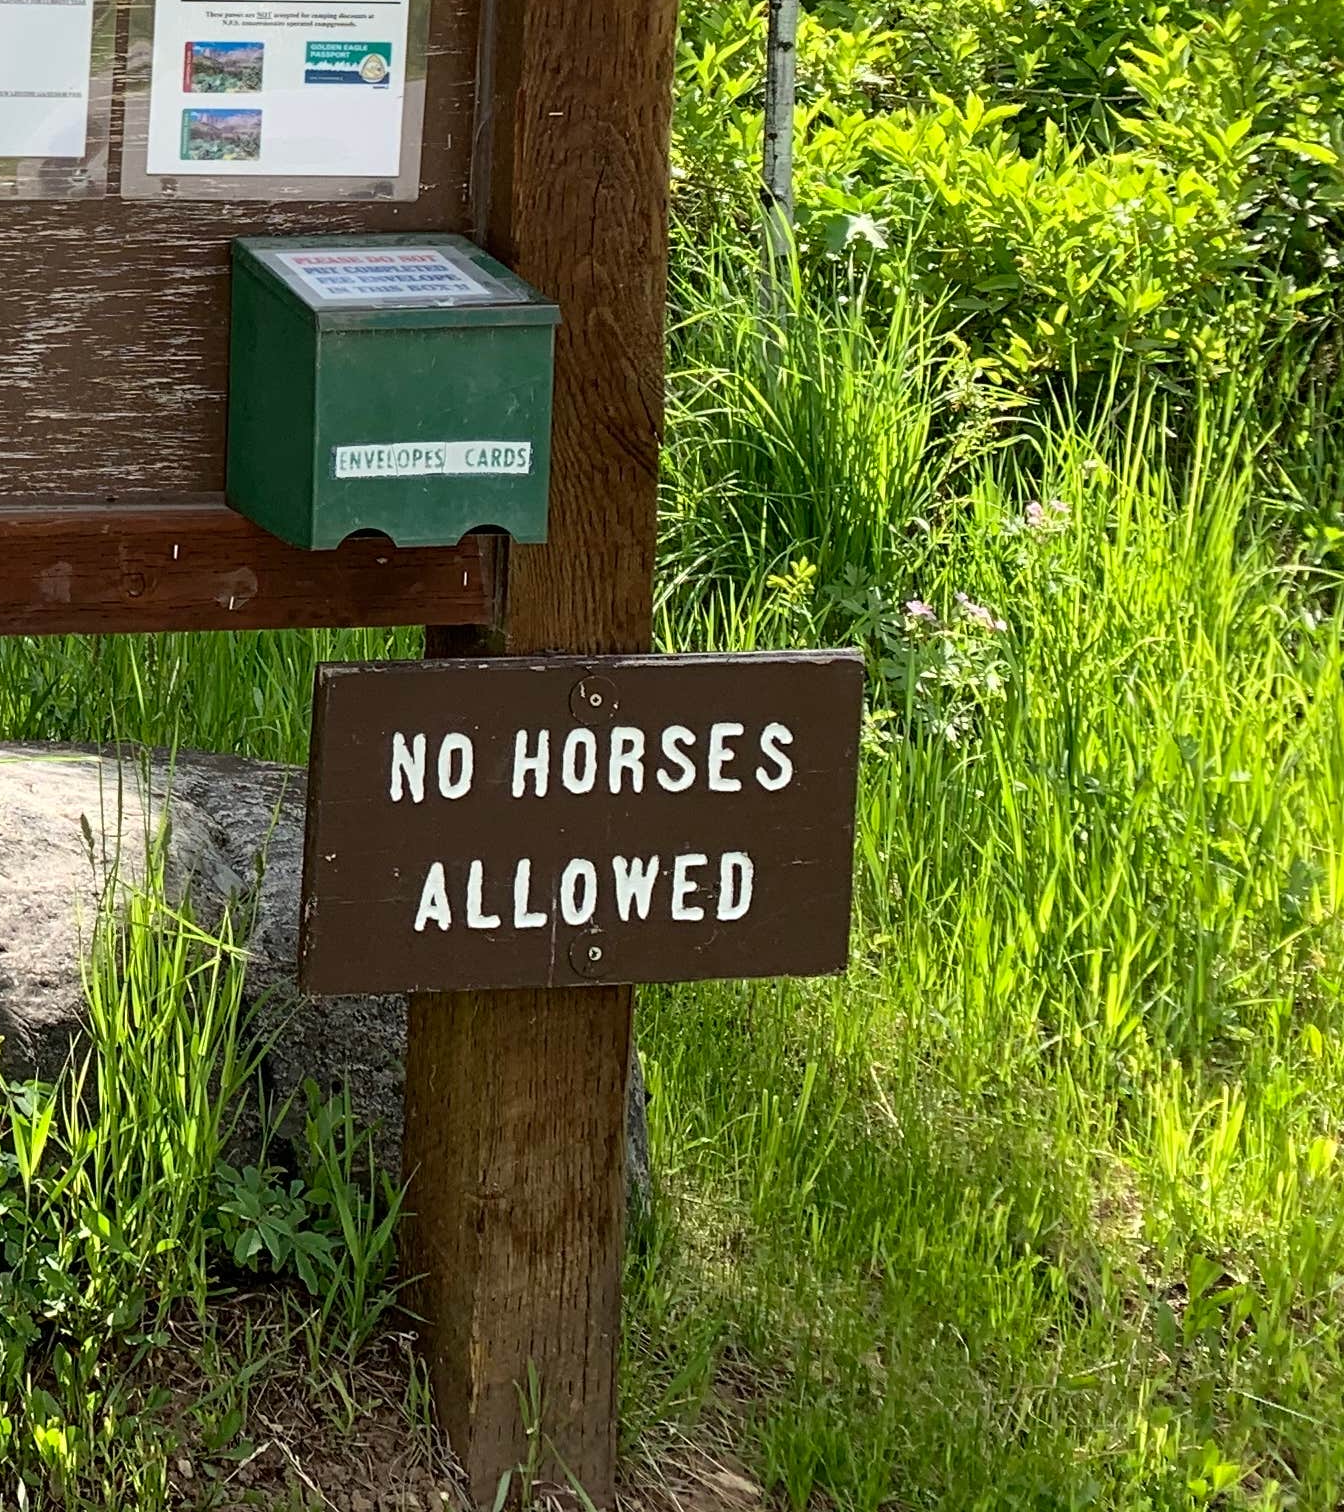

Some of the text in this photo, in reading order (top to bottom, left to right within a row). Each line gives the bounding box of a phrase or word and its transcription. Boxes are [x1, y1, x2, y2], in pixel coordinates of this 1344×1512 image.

[339, 447, 527, 471] ENVELOPES CARDS
[390, 721, 794, 803] NO HORSES
[414, 851, 754, 932] ALLOWED
